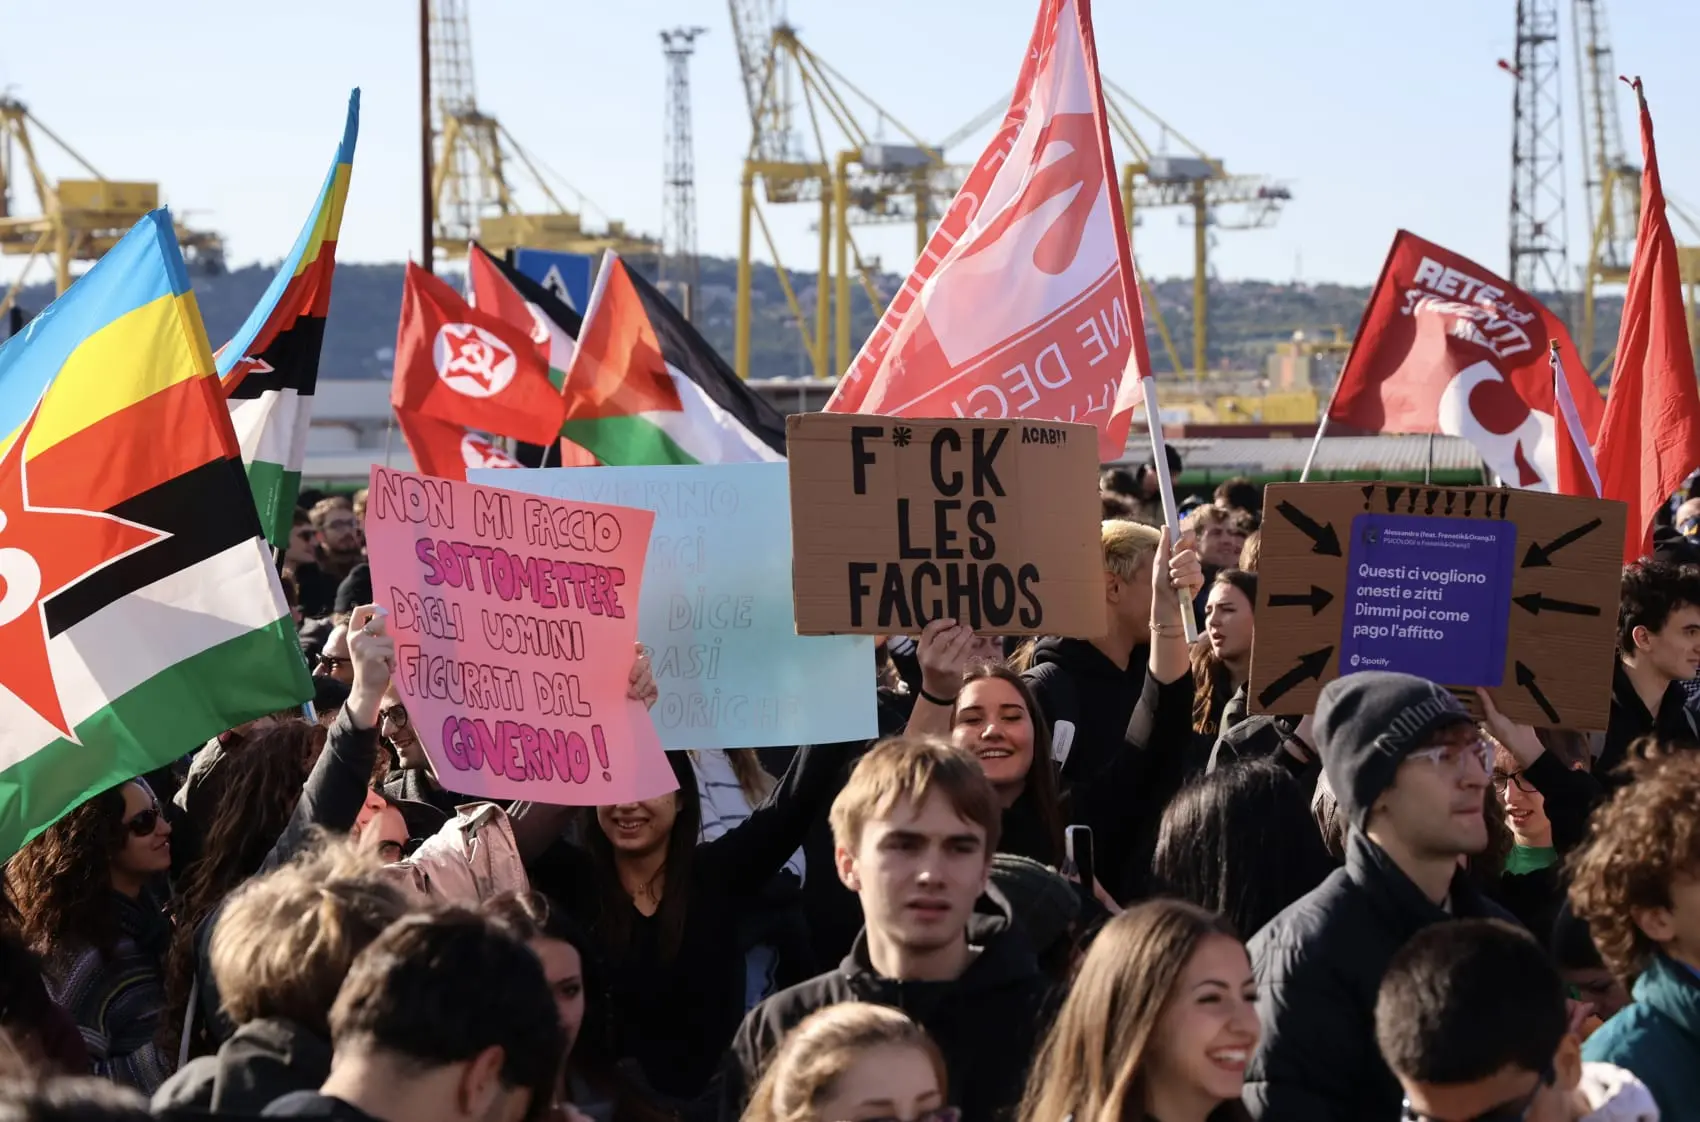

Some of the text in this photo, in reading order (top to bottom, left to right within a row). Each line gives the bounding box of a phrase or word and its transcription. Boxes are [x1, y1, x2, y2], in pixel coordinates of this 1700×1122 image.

[1413, 255, 1505, 305] RETE
[376, 468, 622, 553] NON MI FACCIO
[897, 498, 996, 560] LES
[416, 537, 625, 619] SOTTOMETTERE
[848, 561, 1043, 630] FACHOS
[1356, 585, 1443, 601] onesti e zitti
[1358, 562, 1486, 585] Questi ci vogliono
[390, 586, 585, 661] DAGLI UOMINI
[1353, 625, 1444, 641] pago l'affitto
[1355, 602, 1470, 623] Dimmi poi come
[398, 644, 592, 717] FIGURATI DAL
[1361, 656, 1390, 668] Spotify
